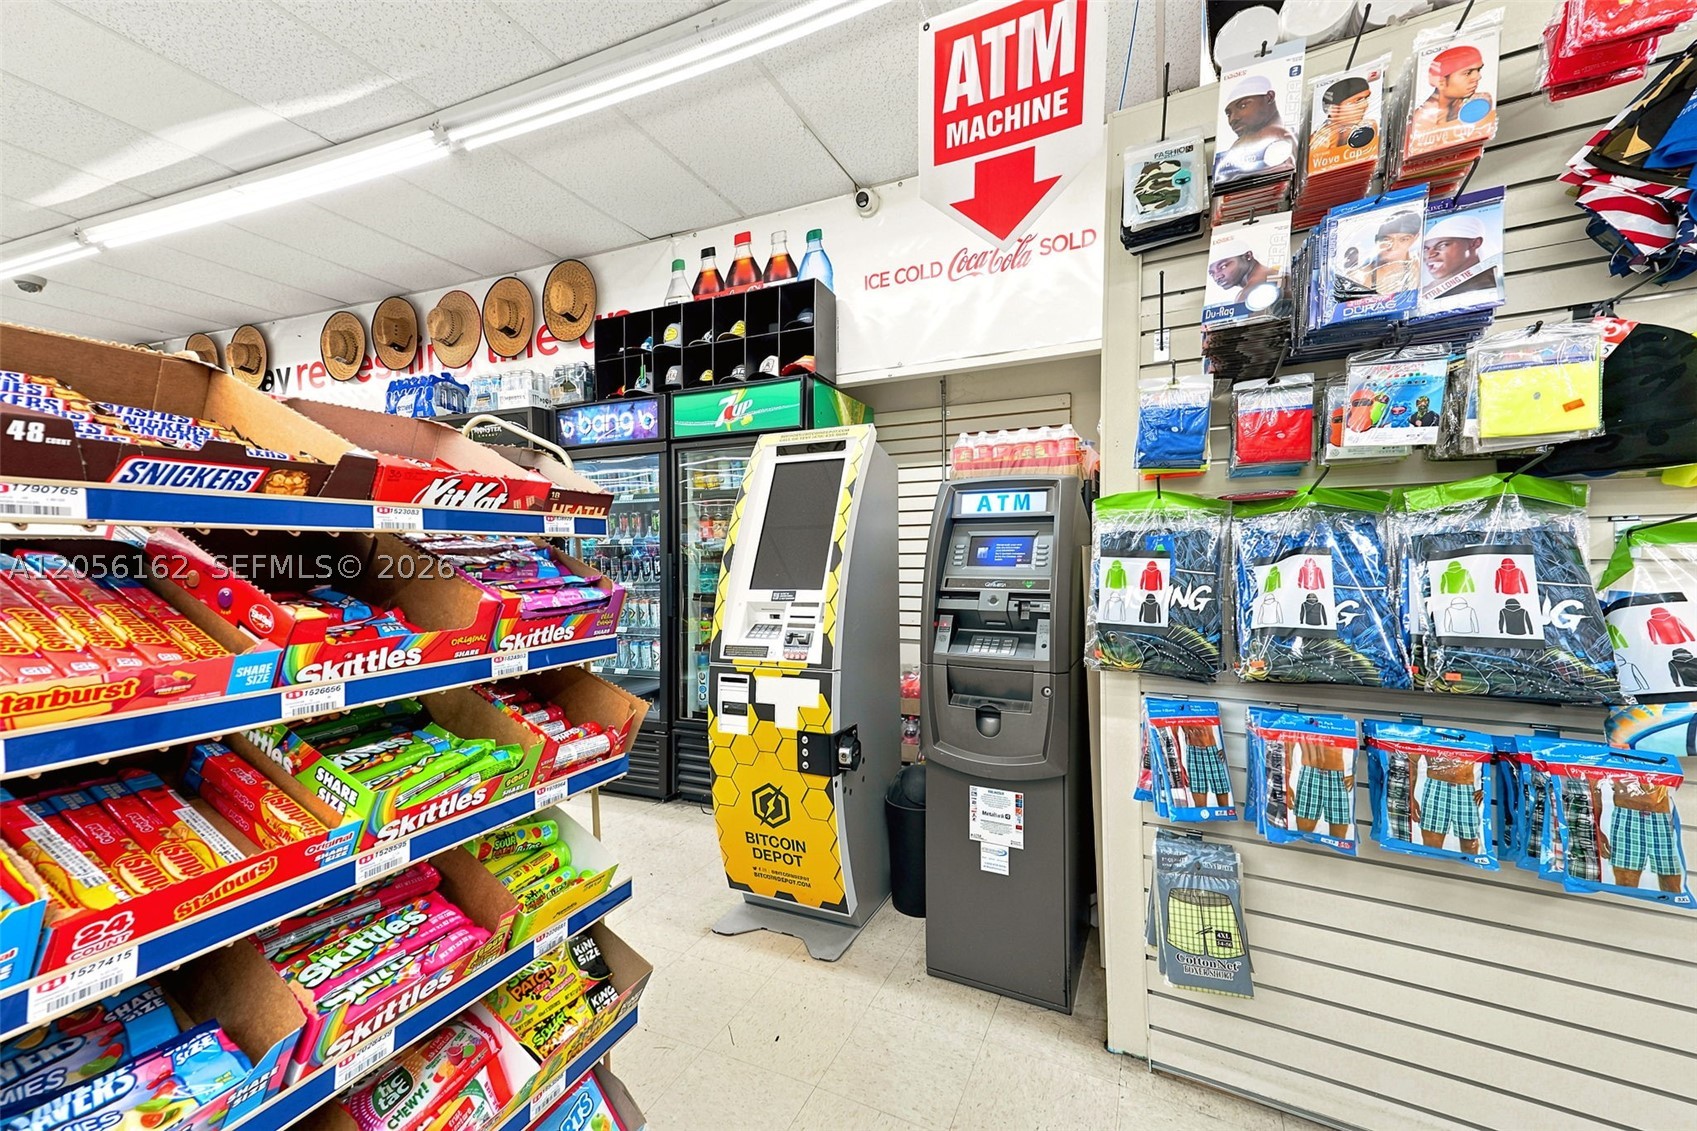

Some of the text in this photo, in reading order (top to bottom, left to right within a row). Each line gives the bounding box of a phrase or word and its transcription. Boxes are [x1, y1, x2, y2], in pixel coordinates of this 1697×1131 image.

[942, 1, 1077, 114] ATM
[946, 87, 1069, 149] MACHINE
[1343, 148, 1362, 162] Cap
[864, 271, 890, 291] ICE
[894, 261, 943, 286] COLD
[1039, 228, 1097, 256] SOLD
[1442, 276, 1462, 292] LONG
[1460, 269, 1473, 280] TIE
[1205, 306, 1235, 320] Du-Rag
[1343, 301, 1396, 317] DURAG
[6, 419, 45, 443] 48
[577, 410, 634, 436] bang
[118, 461, 261, 492] SNICKERS
[12, 484, 80, 496] 1790765
[551, 490, 561, 498] 18
[977, 493, 1031, 512] ATM
[390, 507, 420, 516] 1523083
[551, 503, 606, 516] HEATH
[499, 623, 575, 653] Skittles
[593, 628, 611, 636] SHARE
[296, 646, 423, 684] Skittles
[454, 648, 480, 658] SHARE
[235, 663, 273, 678] SHARE
[245, 673, 269, 686] SIZE
[304, 685, 341, 697] 1526656
[699, 671, 707, 701] core
[315, 766, 359, 807] SHARE
[502, 783, 525, 797] SHARE
[317, 786, 347, 816] SIZE
[375, 787, 487, 847] Skittles
[304, 831, 355, 856] Original
[494, 834, 518, 850] SOUR
[745, 831, 806, 853] BITCOIN
[752, 847, 803, 867] DEPOT
[175, 857, 278, 921] Starburst
[754, 872, 811, 888] BITCOINDEPOT.COM
[72, 910, 135, 950] 24
[65, 930, 135, 965] COUNT
[298, 910, 427, 987] Skittles
[577, 948, 602, 967] SIZE
[70, 949, 134, 980] 1527415
[509, 963, 557, 1001] PATCH
[103, 983, 163, 1023] SHARE
[591, 985, 615, 1007] KING
[326, 968, 454, 1058] Skittles
[175, 1034, 215, 1065] SIZE
[226, 1065, 280, 1104] SHARE
[231, 1080, 269, 1108] SIZE
[381, 1073, 410, 1094] tic
[378, 1084, 411, 1112] tac
[388, 1081, 429, 1130] CHEWY!
